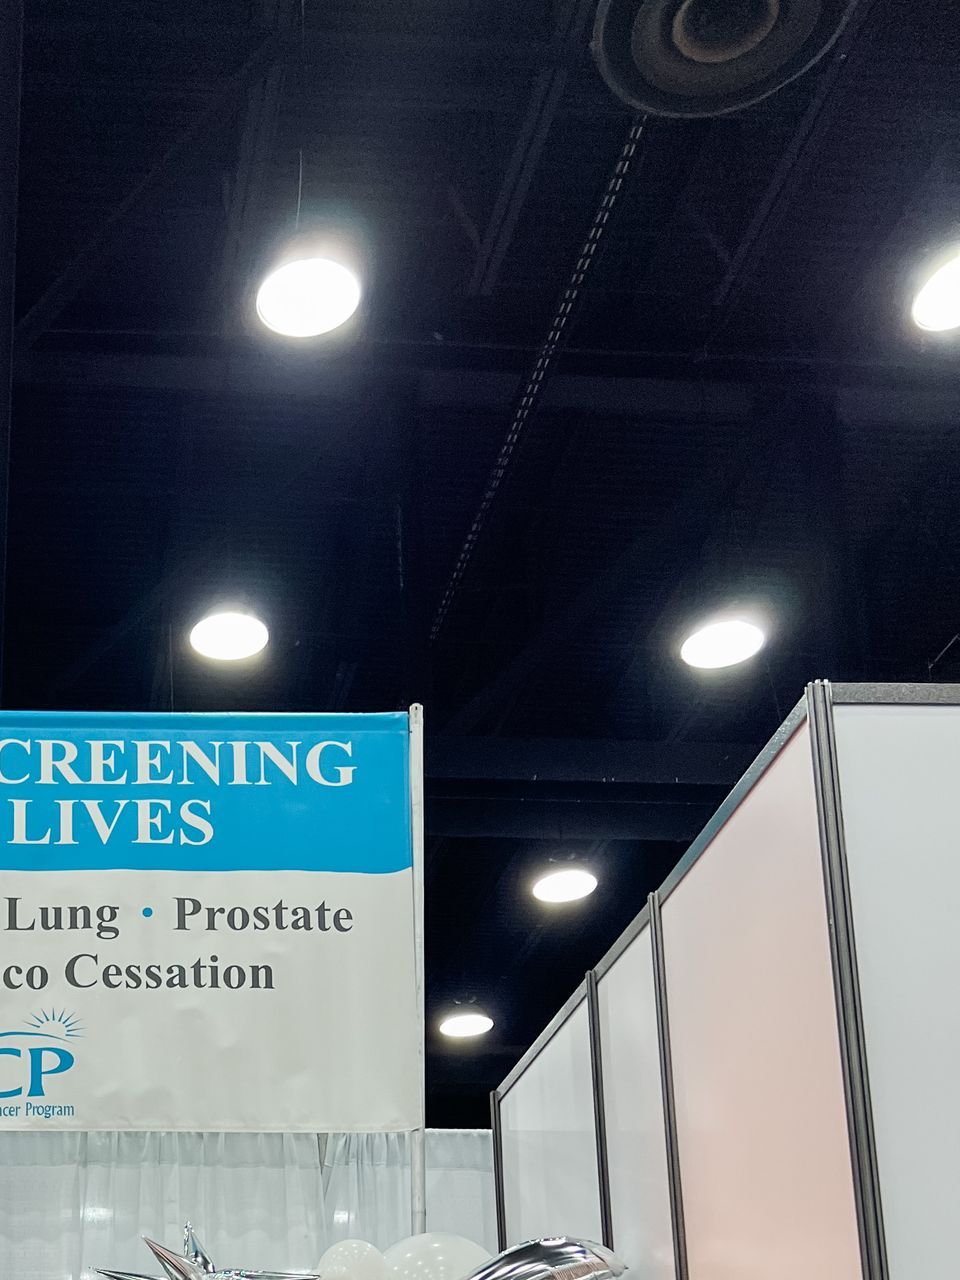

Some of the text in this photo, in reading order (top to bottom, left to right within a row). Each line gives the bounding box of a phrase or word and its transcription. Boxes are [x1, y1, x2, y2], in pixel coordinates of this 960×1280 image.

[10, 799, 215, 847] LIVES
[3, 896, 120, 941] Lung
[173, 896, 354, 934] Prostate
[64, 952, 276, 991] Cessation
[25, 1101, 75, 1119] Program
